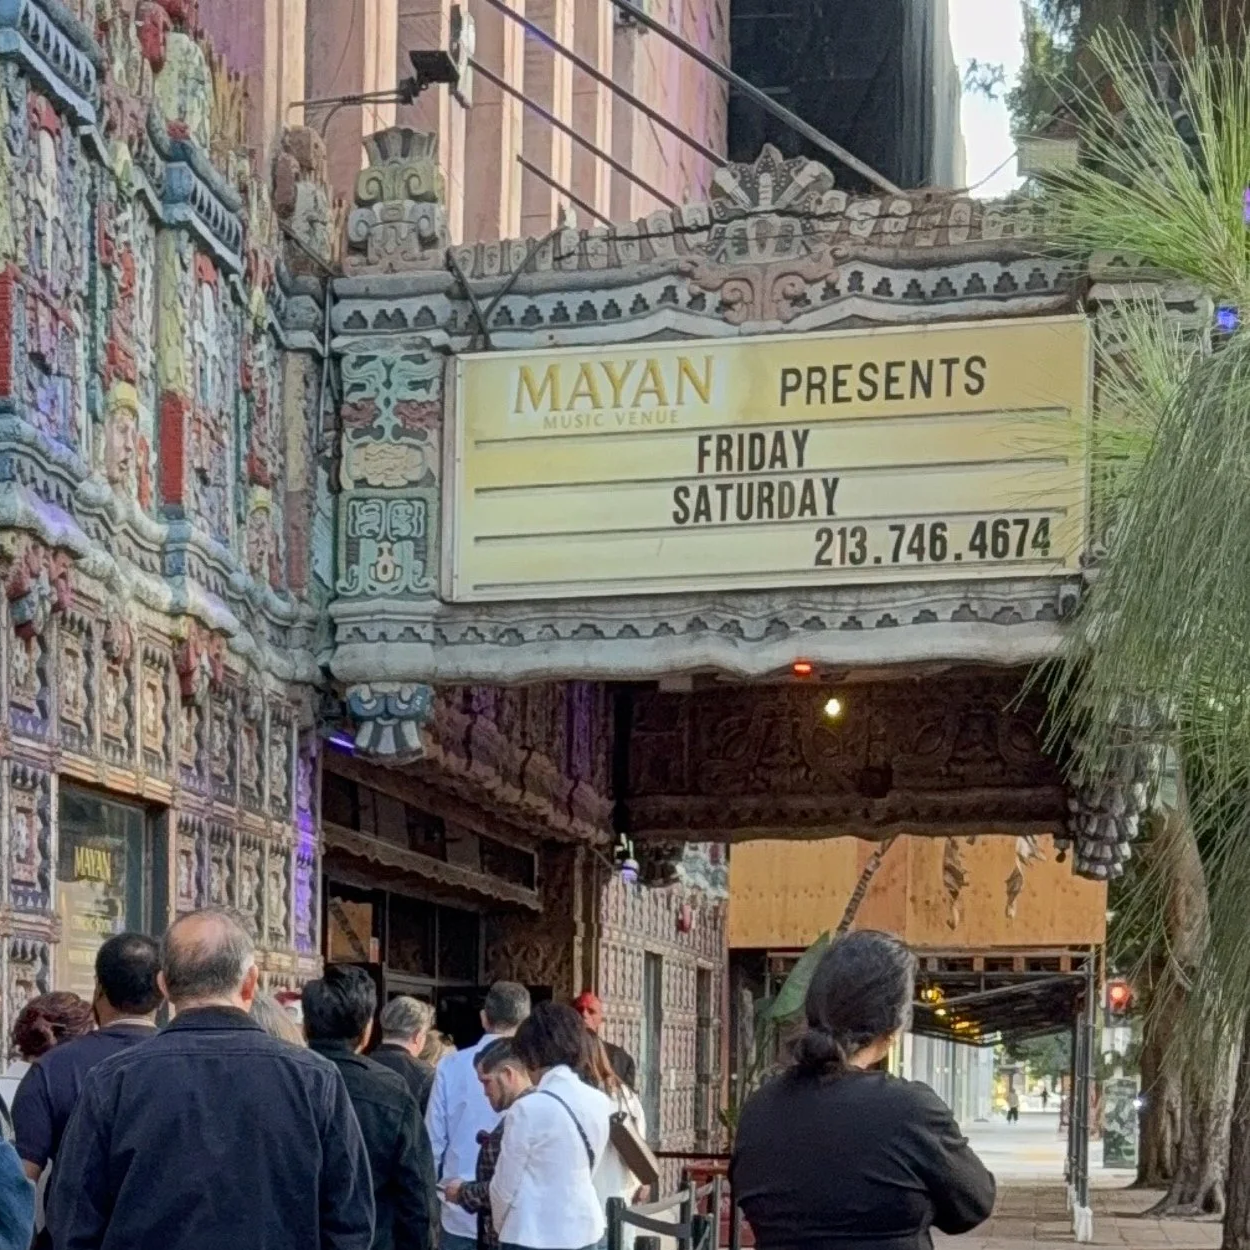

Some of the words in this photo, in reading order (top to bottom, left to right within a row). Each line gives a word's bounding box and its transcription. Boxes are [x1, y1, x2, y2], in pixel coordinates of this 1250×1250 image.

[514, 355, 714, 413] MAYAN
[780, 355, 987, 407] PRESENTS
[543, 413, 605, 430] MUSIC
[614, 409, 679, 427] VENUE
[697, 429, 810, 473] FRIDAY
[672, 477, 840, 525] SATURDAY
[814, 517, 1051, 566] 213.746.4674
